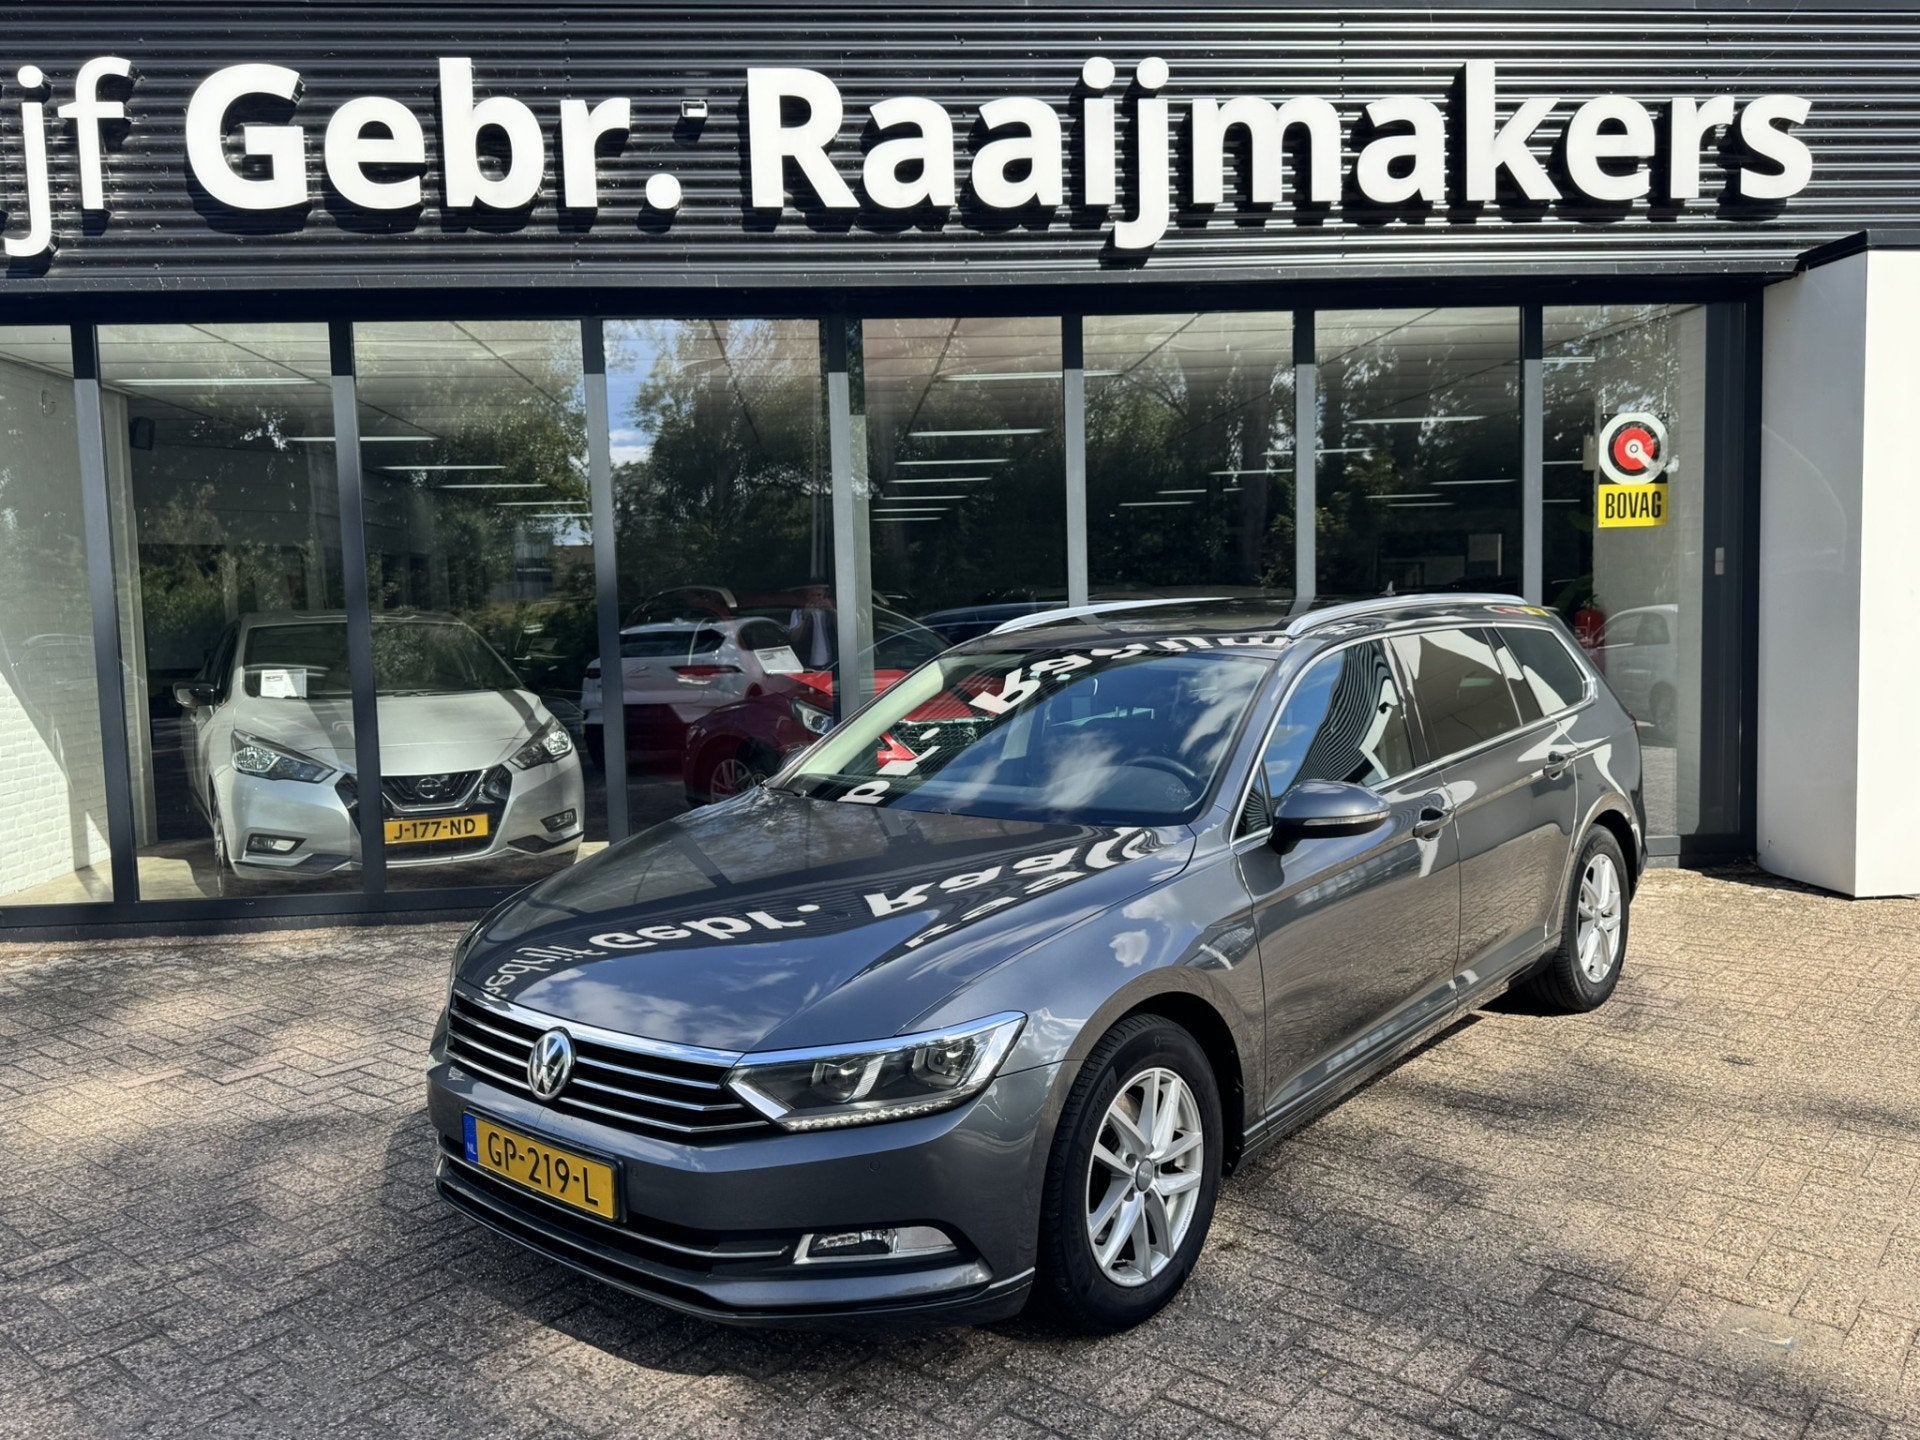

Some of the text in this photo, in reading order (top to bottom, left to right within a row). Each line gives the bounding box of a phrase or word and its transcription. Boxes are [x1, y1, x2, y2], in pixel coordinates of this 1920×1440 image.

[186, 57, 683, 210] Gebr.
[747, 56, 1813, 250] Raaijmakers
[1605, 491, 1662, 519] BOVAG
[394, 818, 476, 840] J-177-ND
[488, 1131, 599, 1207] GP-219-L
